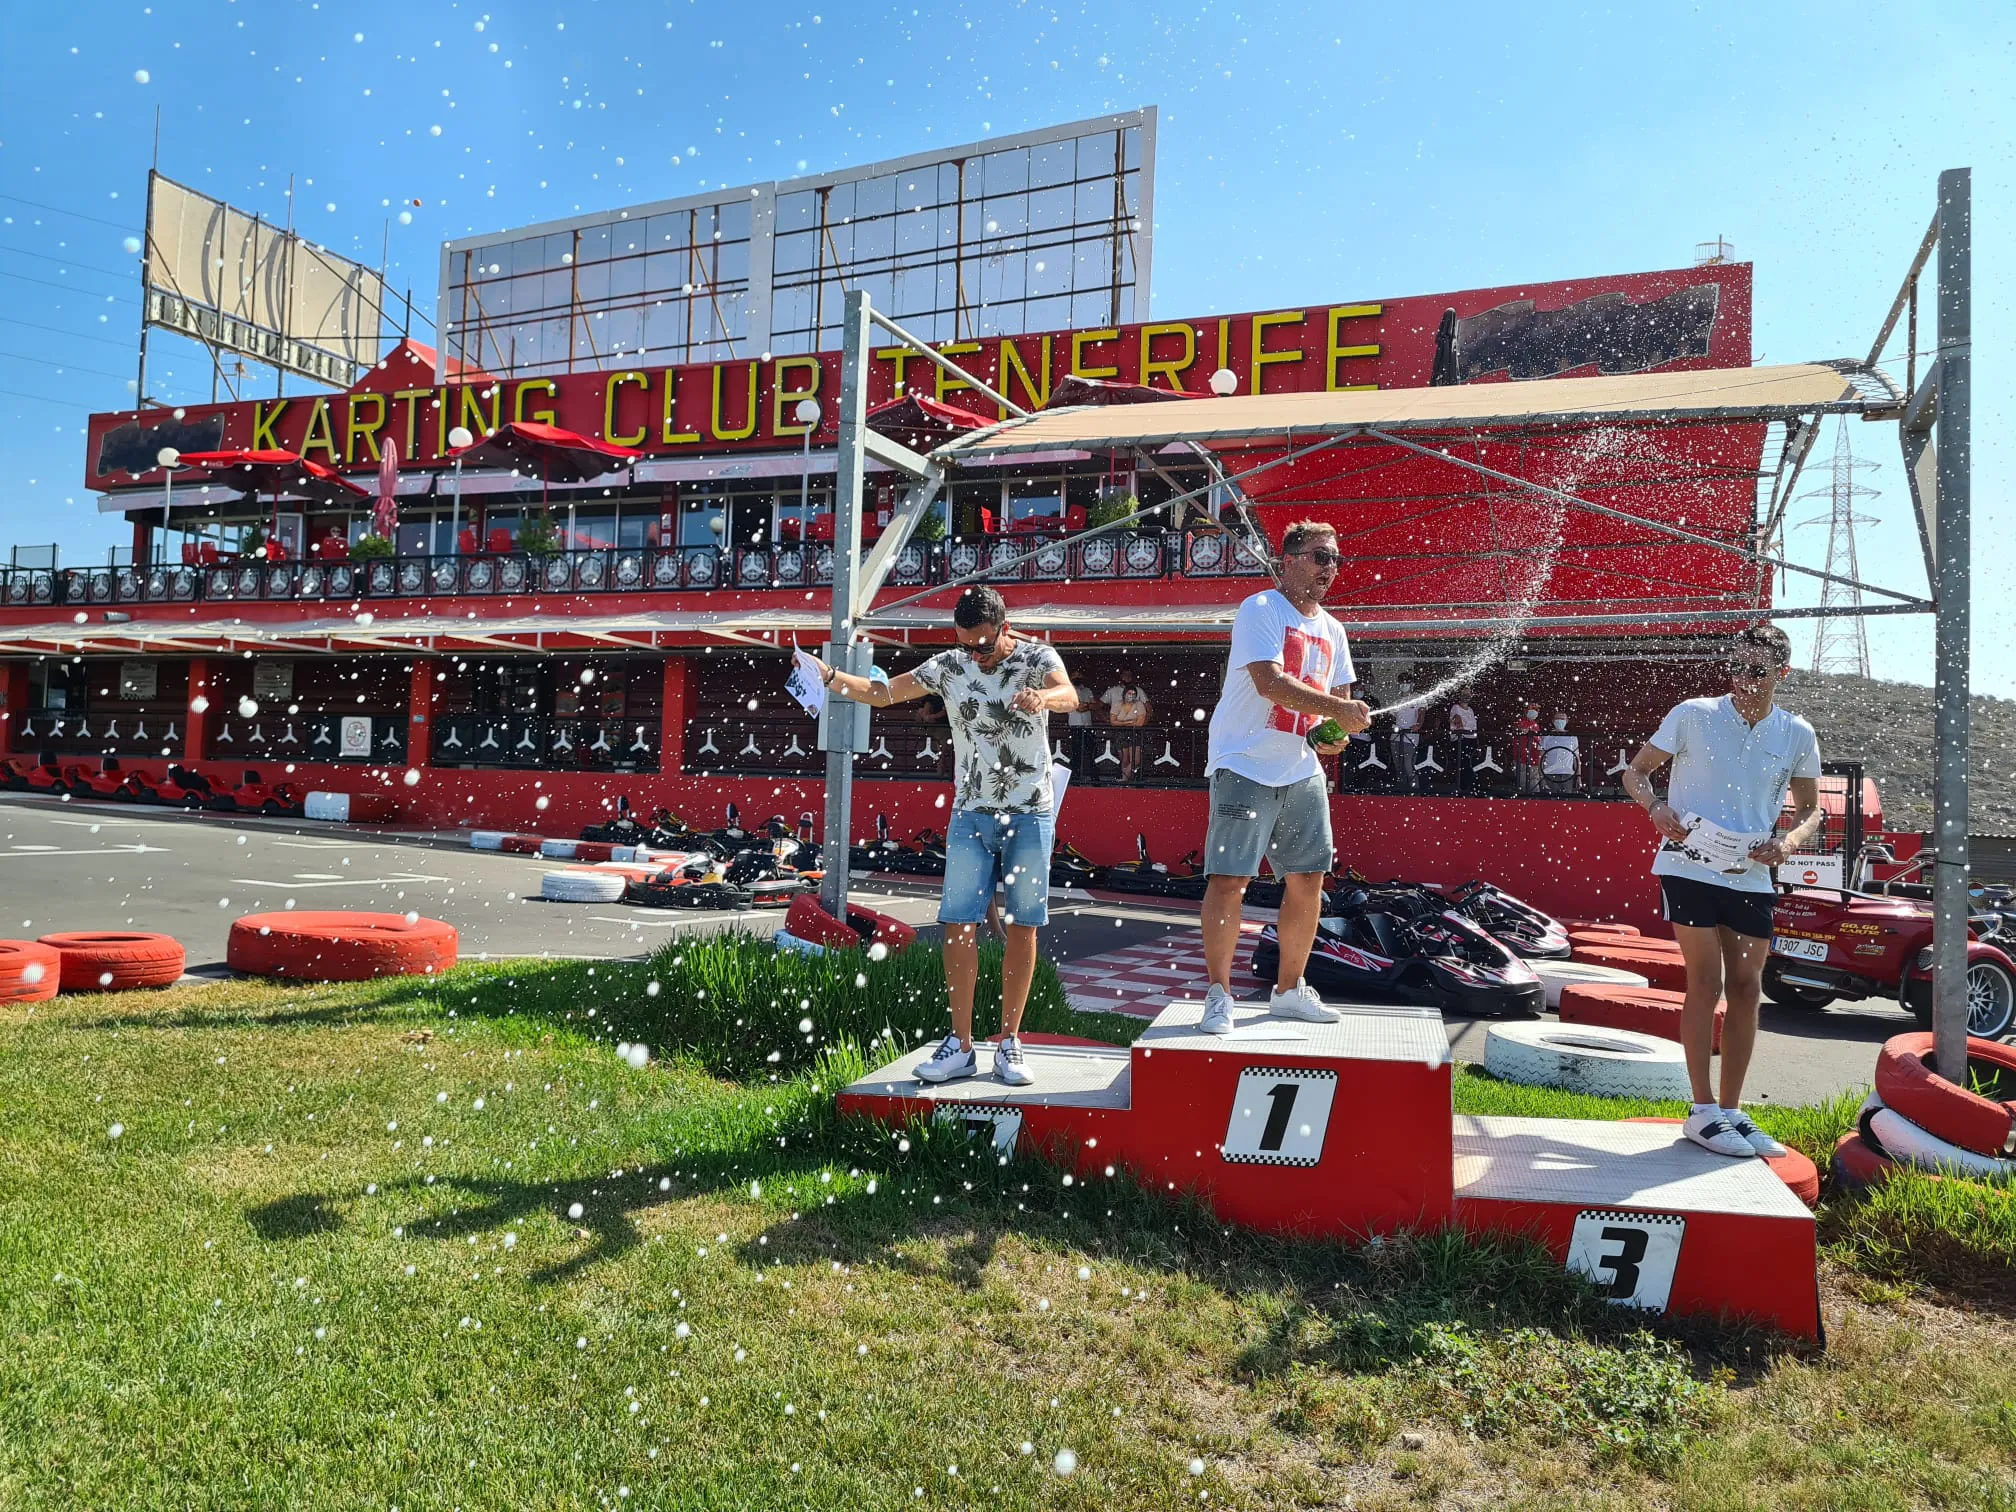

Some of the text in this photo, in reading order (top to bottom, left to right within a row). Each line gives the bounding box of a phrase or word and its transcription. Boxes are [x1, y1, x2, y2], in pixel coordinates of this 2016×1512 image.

[253, 304, 1383, 464] KARTING CLUB TENERIFE
[1778, 939, 1825, 957] 1307 JSC
[1259, 1083, 1300, 1151] 1
[1592, 1226, 1649, 1300] 3
